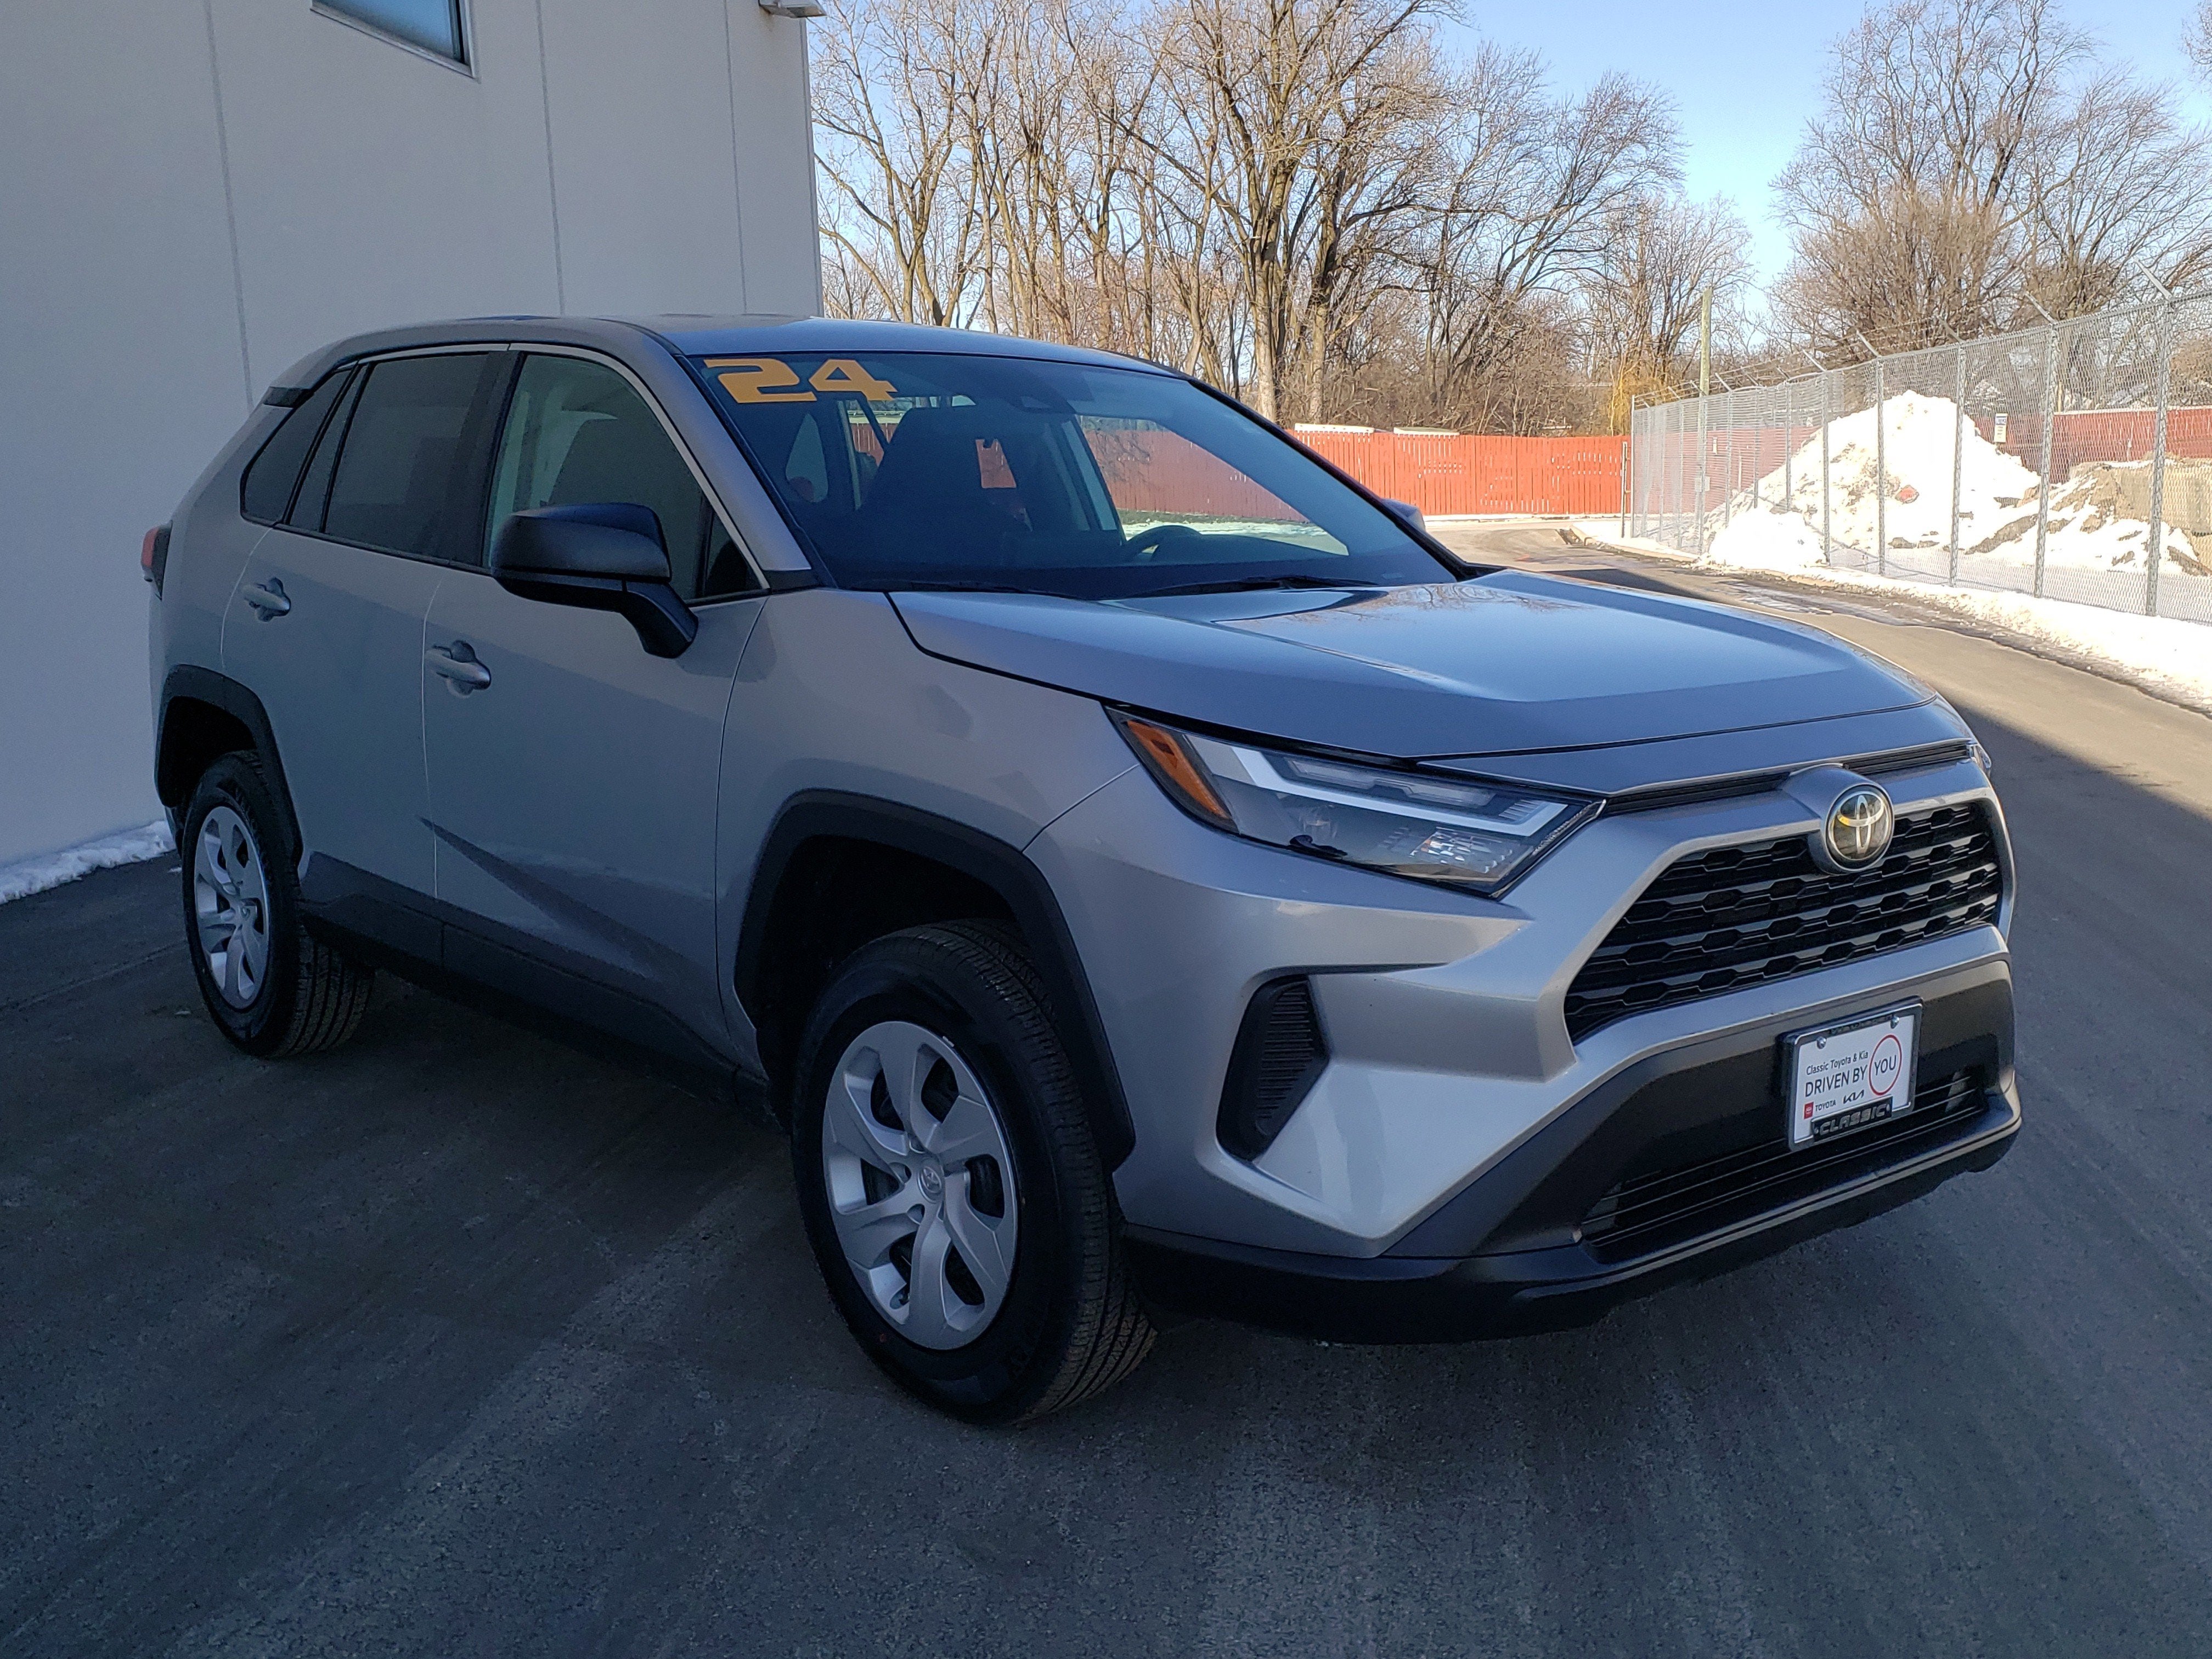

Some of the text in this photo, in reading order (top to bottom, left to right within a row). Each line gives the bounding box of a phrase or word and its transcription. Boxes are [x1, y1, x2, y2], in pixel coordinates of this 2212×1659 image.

[703, 358, 898, 403] 24
[1805, 1055, 1897, 1097] DRIVEN BY YOU
[1806, 1051, 1869, 1075] Classic Toyota & Kia
[1815, 1099, 1836, 1111] TOYOTA
[1819, 1103, 1887, 1136] CLASSIC
